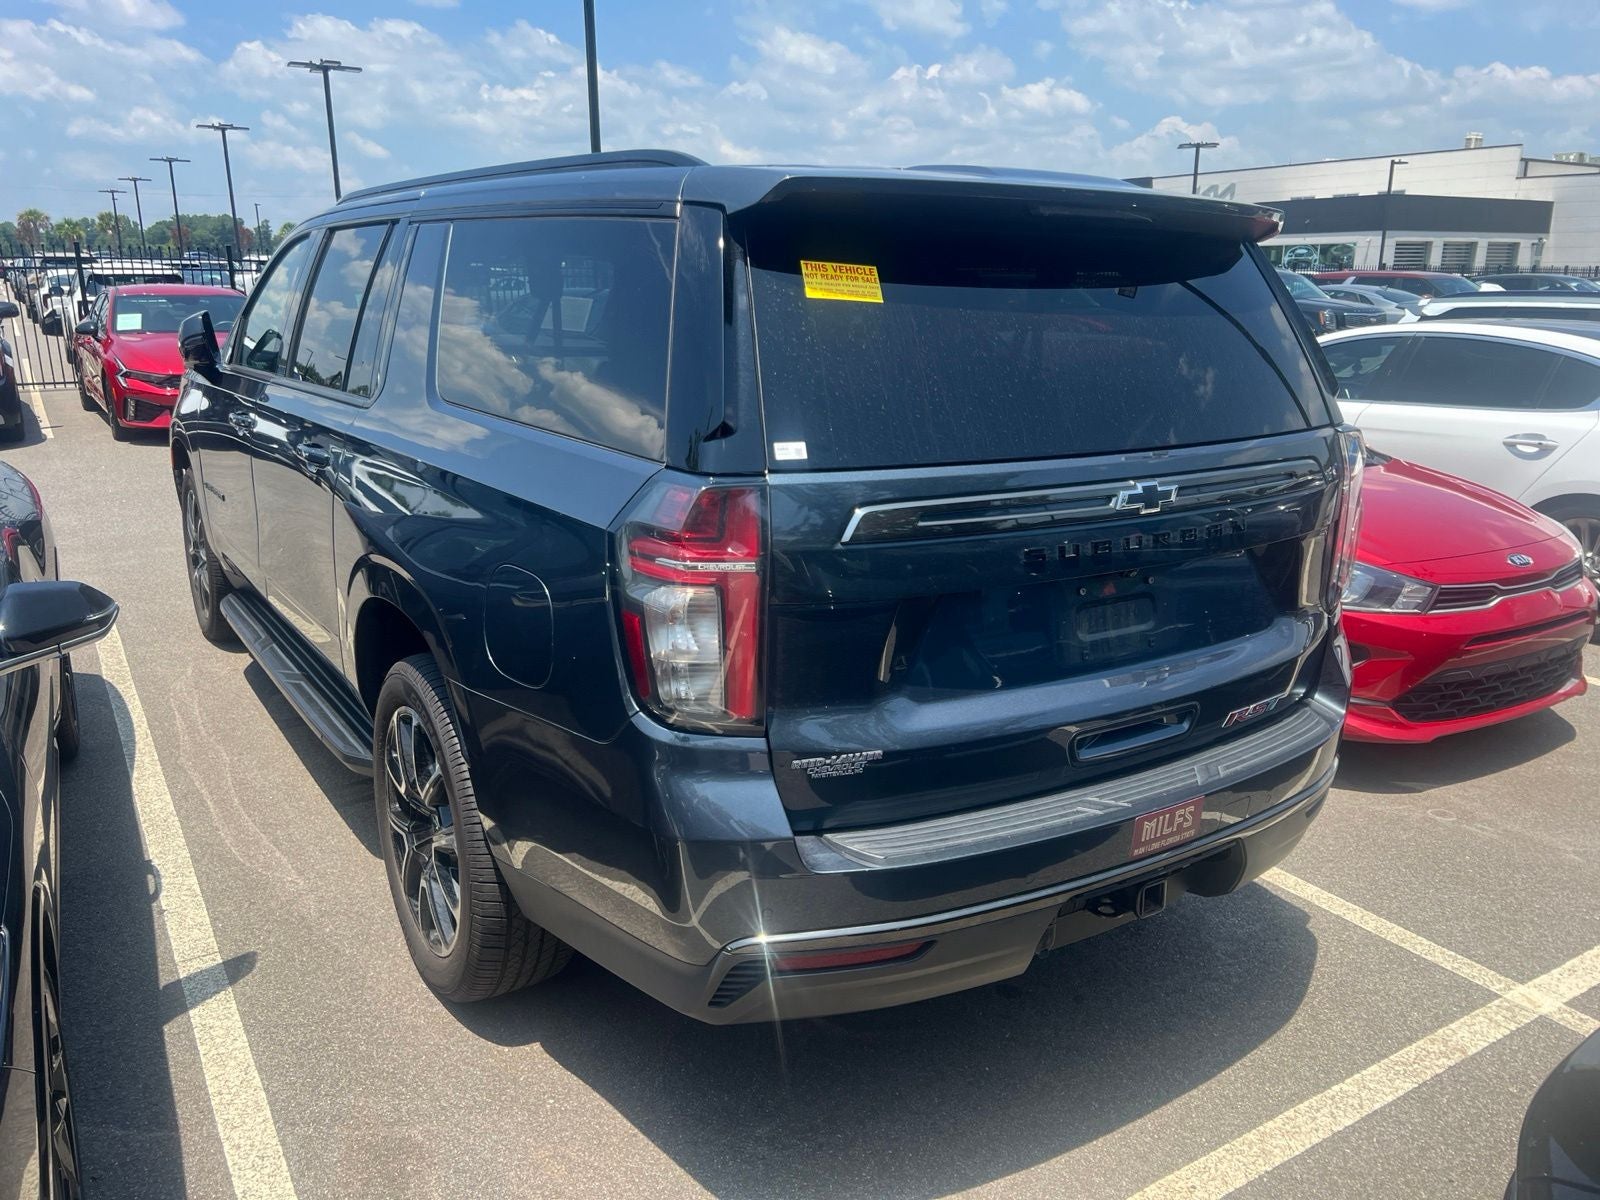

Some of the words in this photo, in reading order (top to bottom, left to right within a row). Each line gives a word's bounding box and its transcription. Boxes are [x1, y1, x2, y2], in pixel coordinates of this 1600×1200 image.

[804, 262, 828, 272] THIS
[831, 264, 875, 276] VEHICLE
[805, 271, 818, 279] NOT
[820, 272, 843, 281] READY
[861, 276, 878, 284] SALE
[1022, 512, 1247, 562] SUBURBAN
[1222, 694, 1282, 728] RST
[807, 761, 868, 774] CHEVROLET
[1141, 806, 1195, 841] MILFS
[1133, 846, 1145, 856] MAN
[1148, 841, 1161, 852] LOVE
[1180, 829, 1195, 840] STATE
